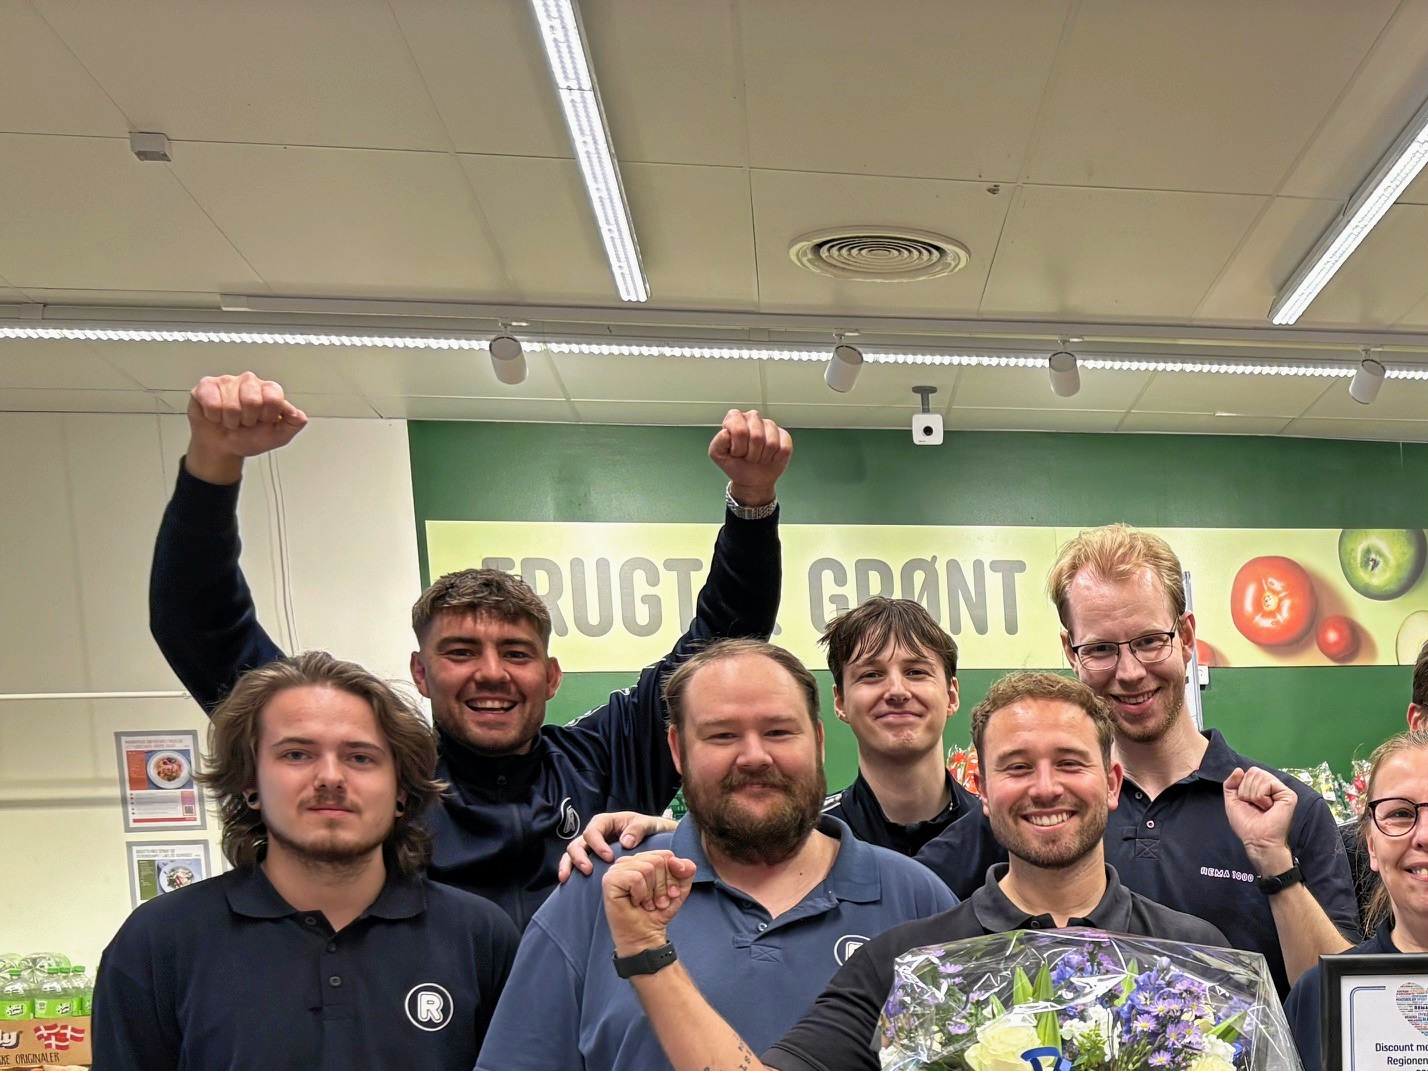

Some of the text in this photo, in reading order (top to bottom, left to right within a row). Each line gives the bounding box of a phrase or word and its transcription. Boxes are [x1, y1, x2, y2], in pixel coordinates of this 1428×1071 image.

[482, 557, 704, 637] RUGT
[1200, 866, 1254, 882] REMA 1000
[1375, 1042, 1414, 1052] Discount
[16, 1052, 60, 1064] ORIGINALER
